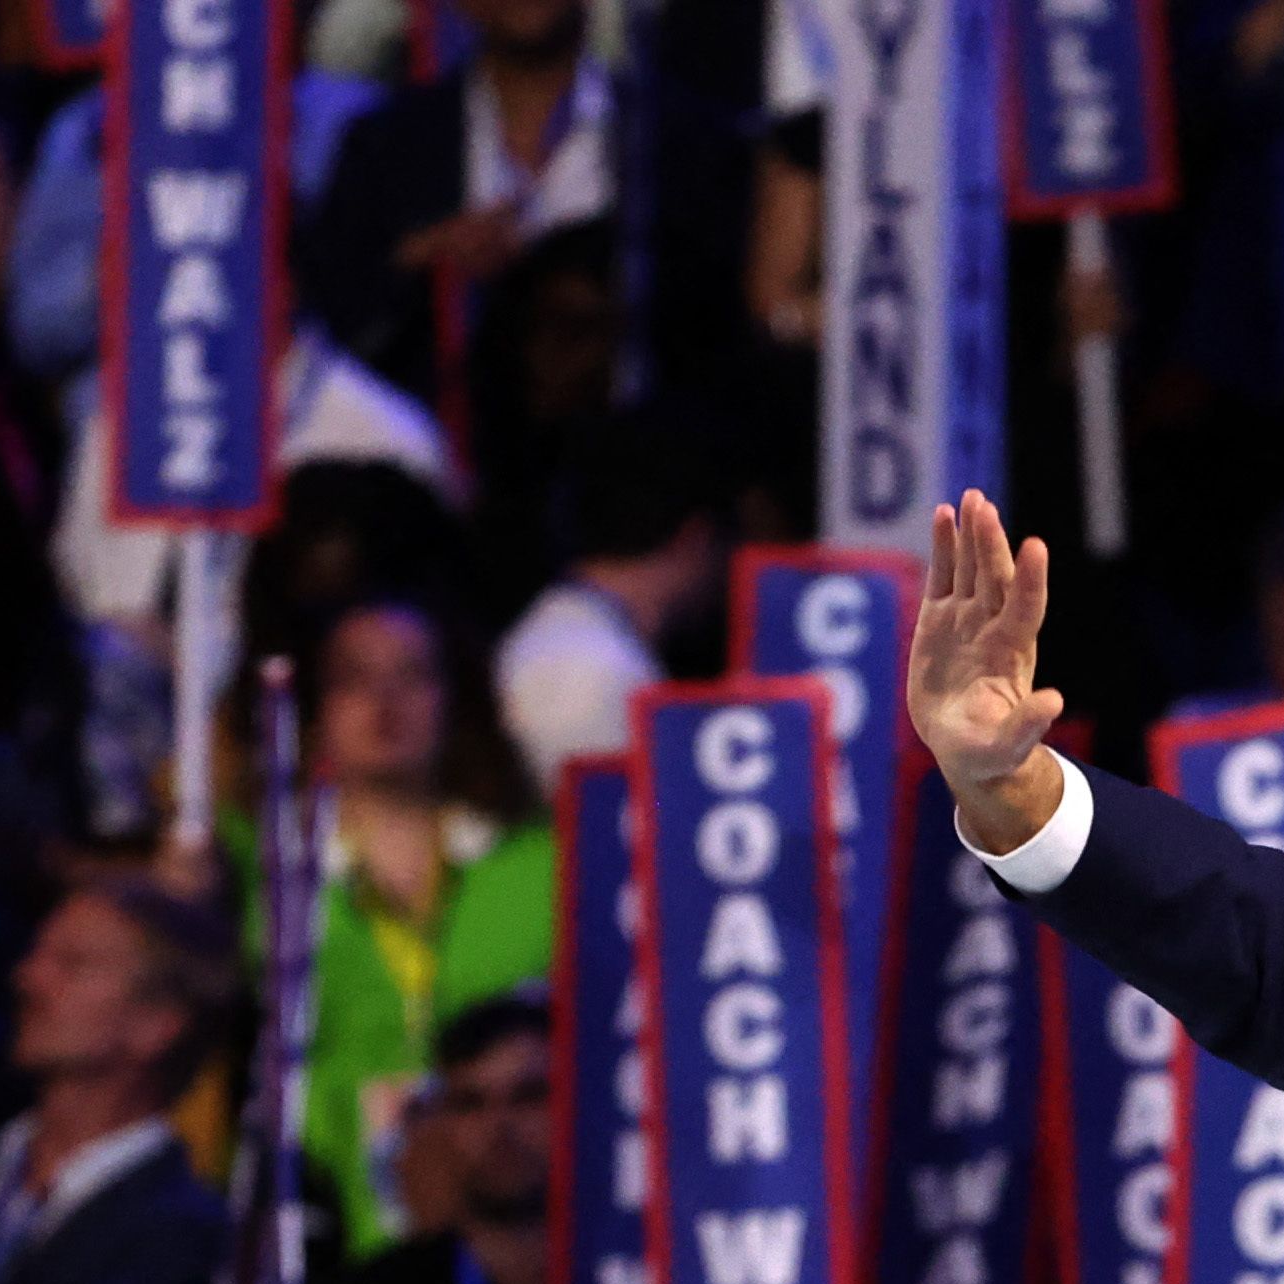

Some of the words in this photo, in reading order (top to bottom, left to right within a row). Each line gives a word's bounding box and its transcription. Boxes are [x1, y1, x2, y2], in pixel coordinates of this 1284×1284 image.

[146, 171, 248, 489] WALZ
[845, 0, 919, 523] YLAND
[693, 706, 789, 1164] COACH
[928, 852, 1017, 1132] ACH
